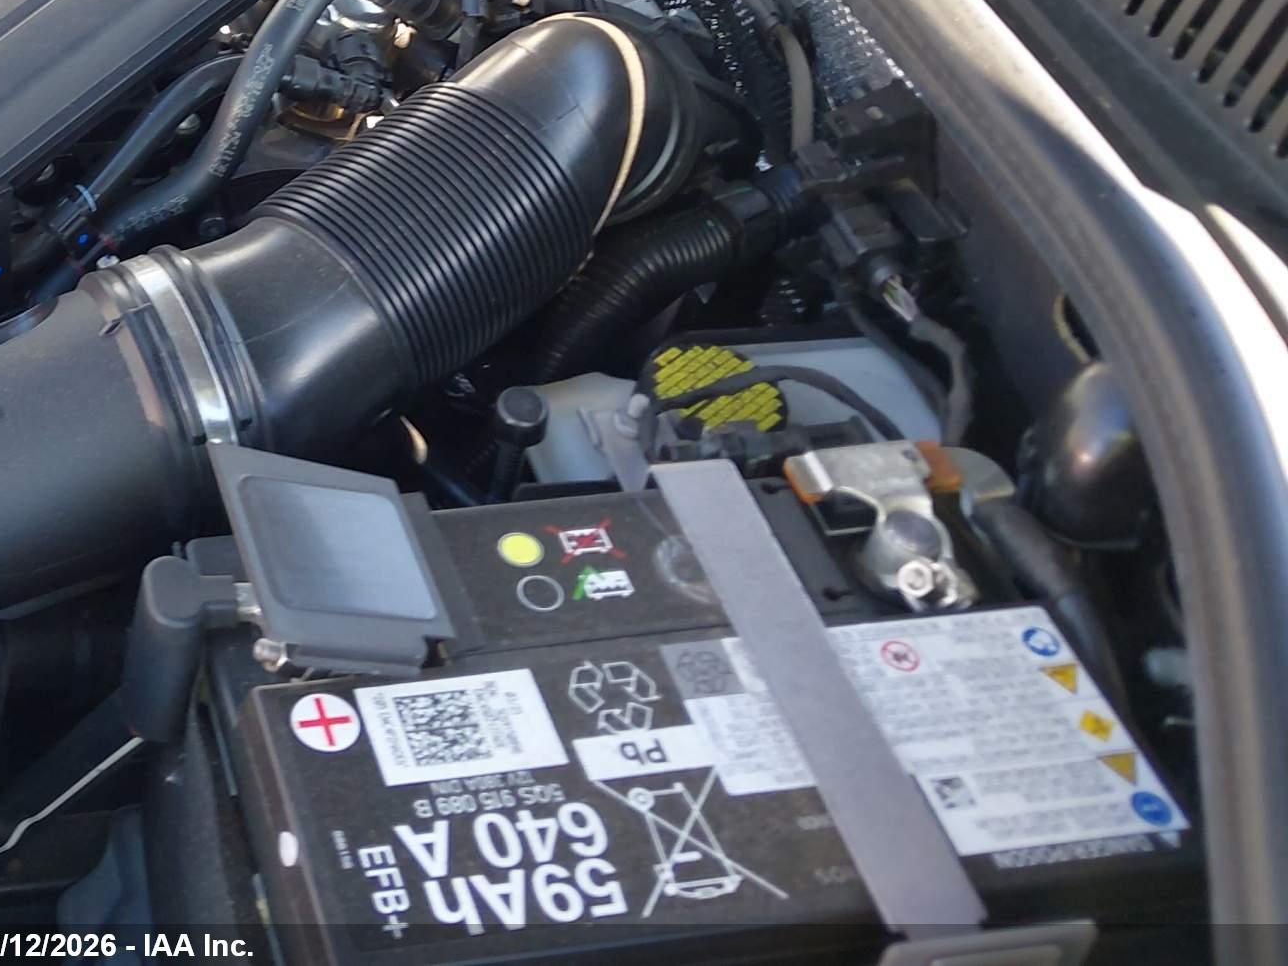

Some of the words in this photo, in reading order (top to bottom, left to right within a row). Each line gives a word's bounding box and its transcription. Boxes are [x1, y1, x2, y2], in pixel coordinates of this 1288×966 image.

[619, 738, 669, 766] Pb
[412, 798, 435, 819] B
[471, 801, 609, 869] 640
[393, 819, 450, 878] A
[357, 844, 411, 940] EFB+
[423, 857, 629, 936] 59Ah
